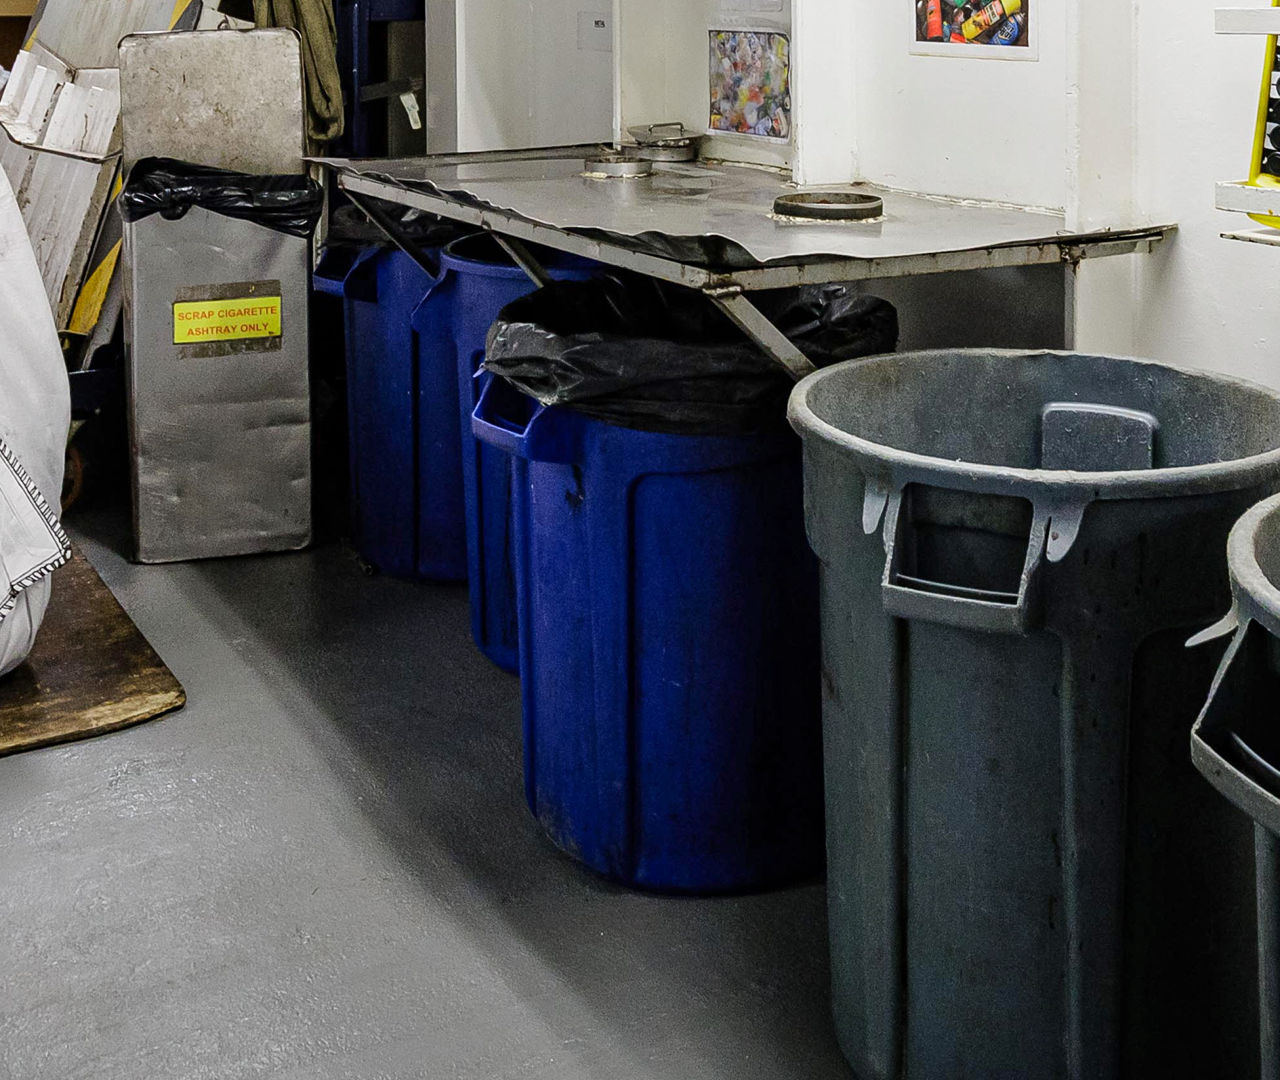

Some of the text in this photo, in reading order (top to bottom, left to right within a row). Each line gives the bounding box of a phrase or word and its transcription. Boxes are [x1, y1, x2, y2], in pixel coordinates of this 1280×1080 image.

[177, 305, 278, 321] SCRAP CIGARETTE
[187, 323, 269, 336] ASHTRAY ONLY
